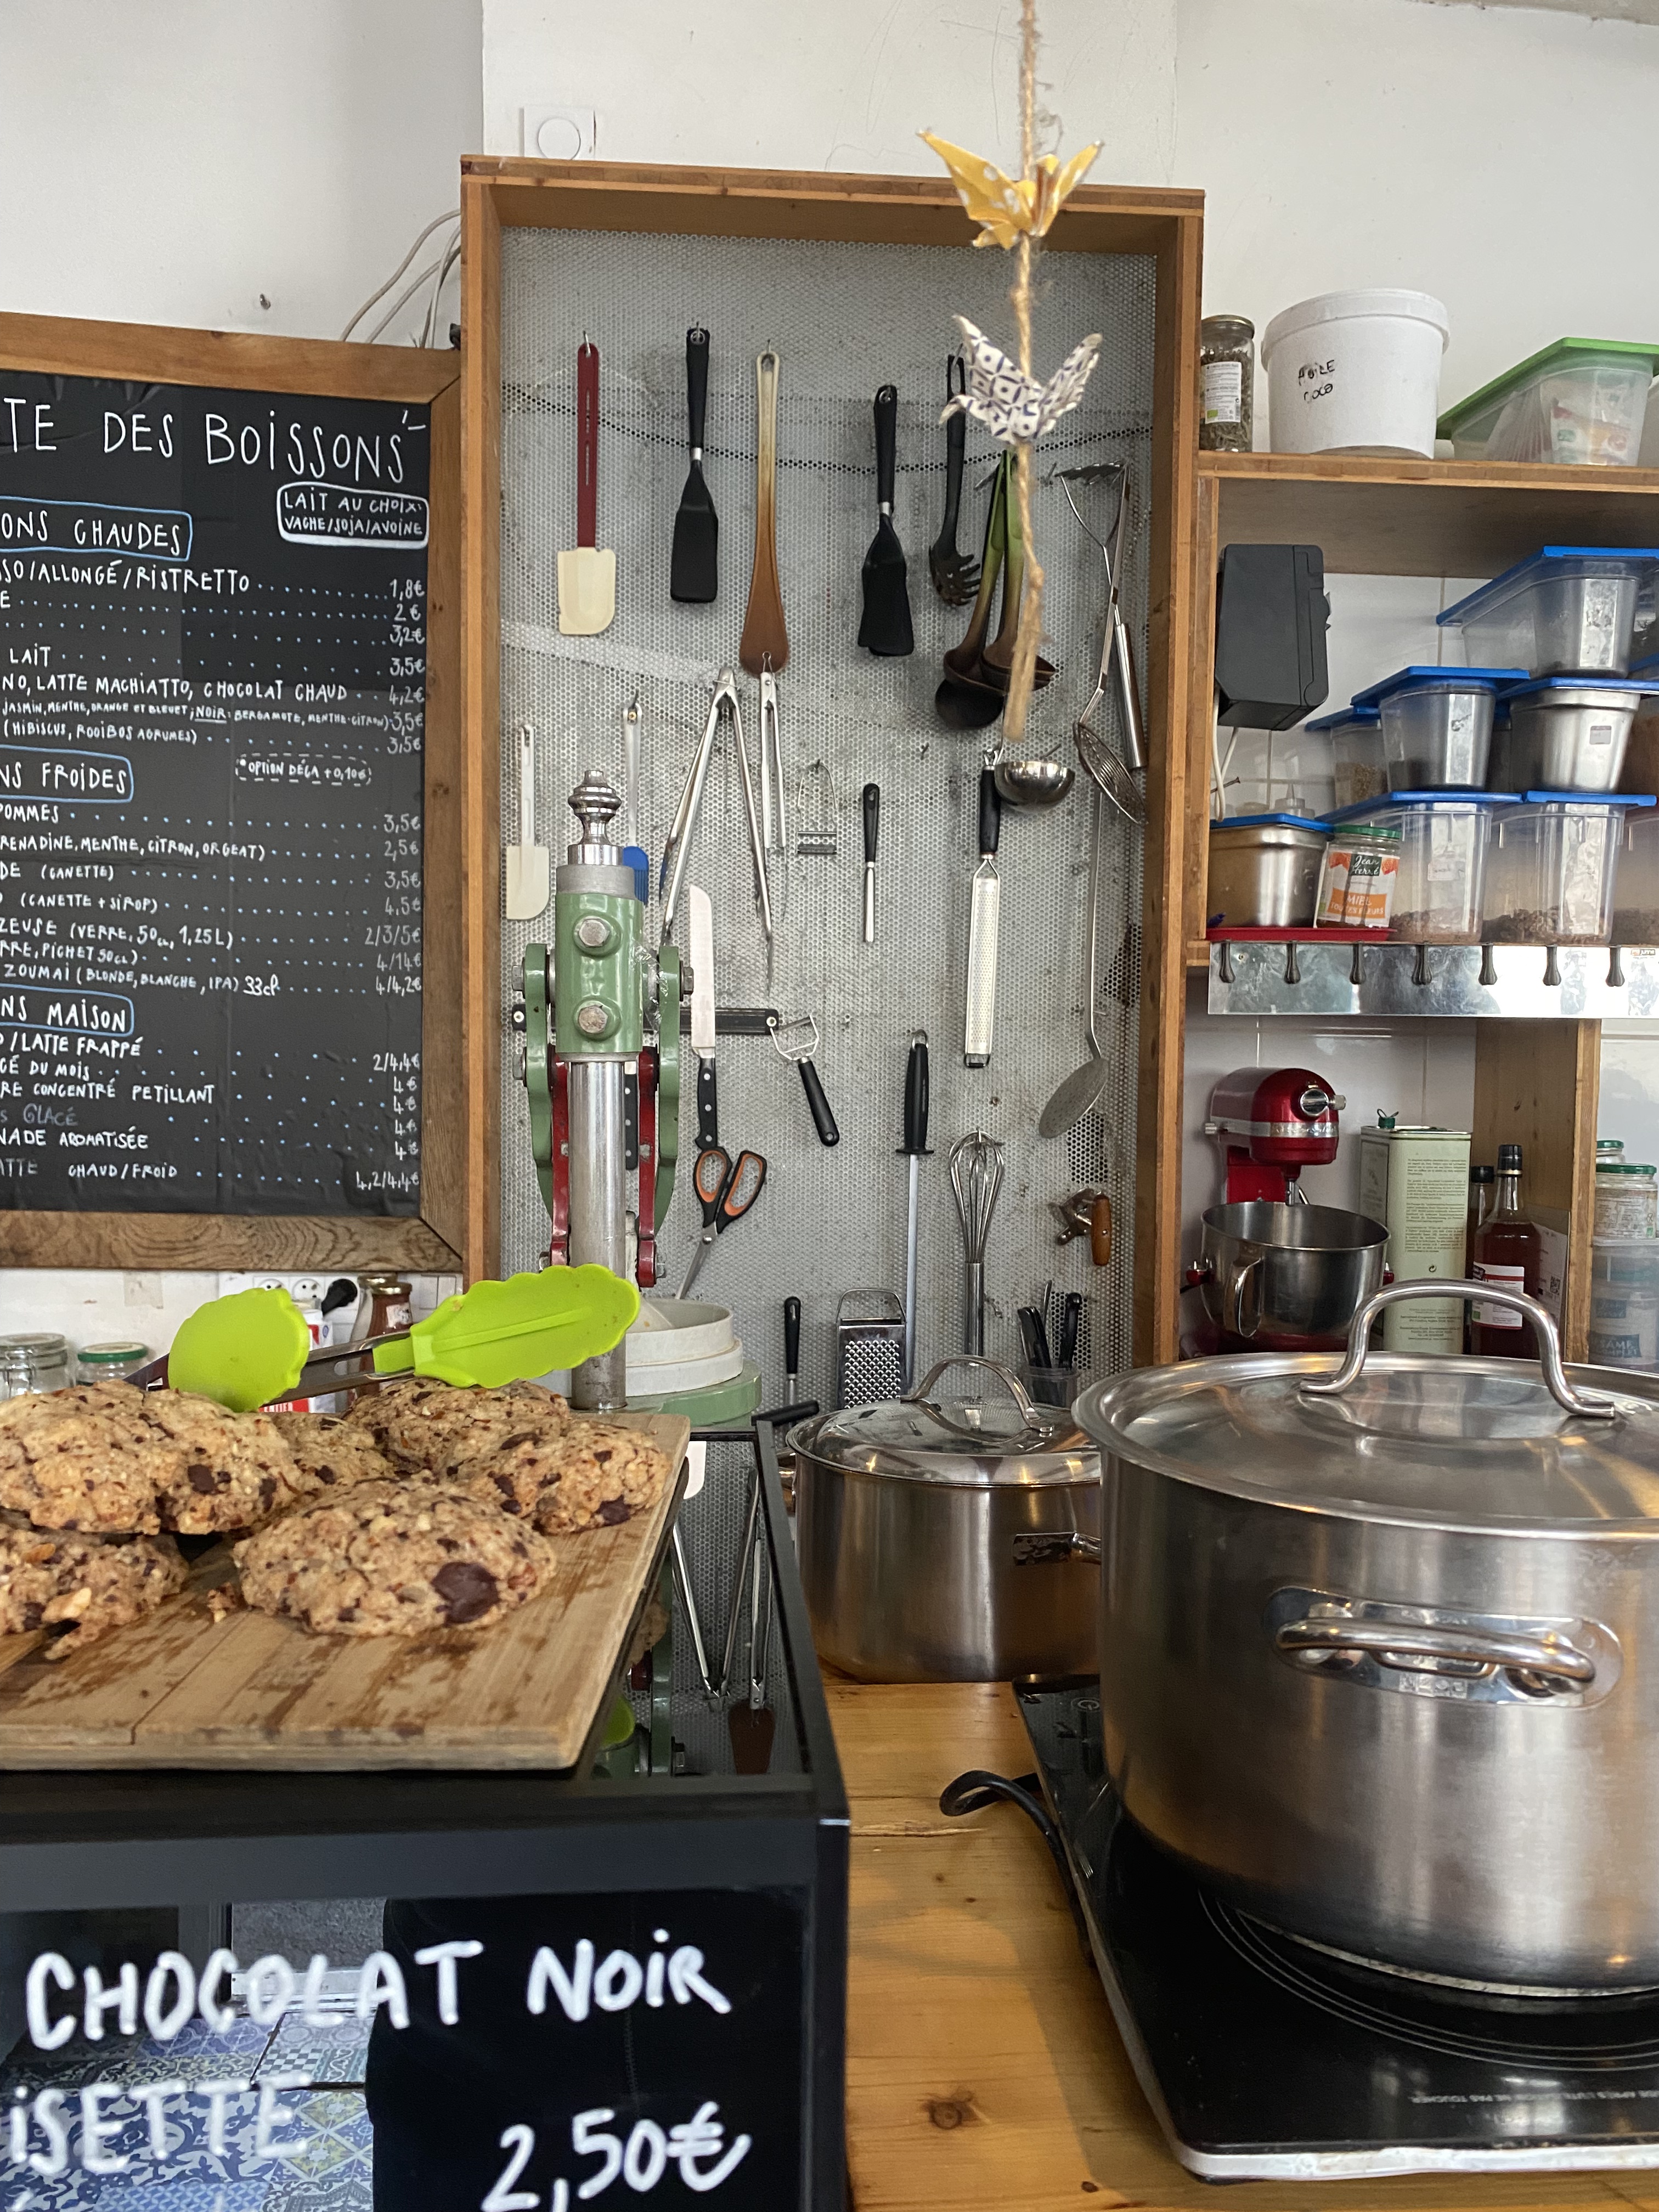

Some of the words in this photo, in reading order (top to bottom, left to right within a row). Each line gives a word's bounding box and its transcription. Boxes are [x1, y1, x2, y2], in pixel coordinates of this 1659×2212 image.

[104, 411, 173, 458] DES
[338, 496, 362, 512] AU
[74, 519, 180, 556] CHAUDES
[37, 673, 87, 691] LATTE
[295, 684, 347, 703] CHAUD
[1331, 902, 1357, 915] TOUES
[1358, 907, 1384, 915] FEURS
[76, 1036, 144, 1059] FRAPPÉ
[29, 1060, 48, 1075] DU
[24, 1938, 485, 2052] CHOCOLAT
